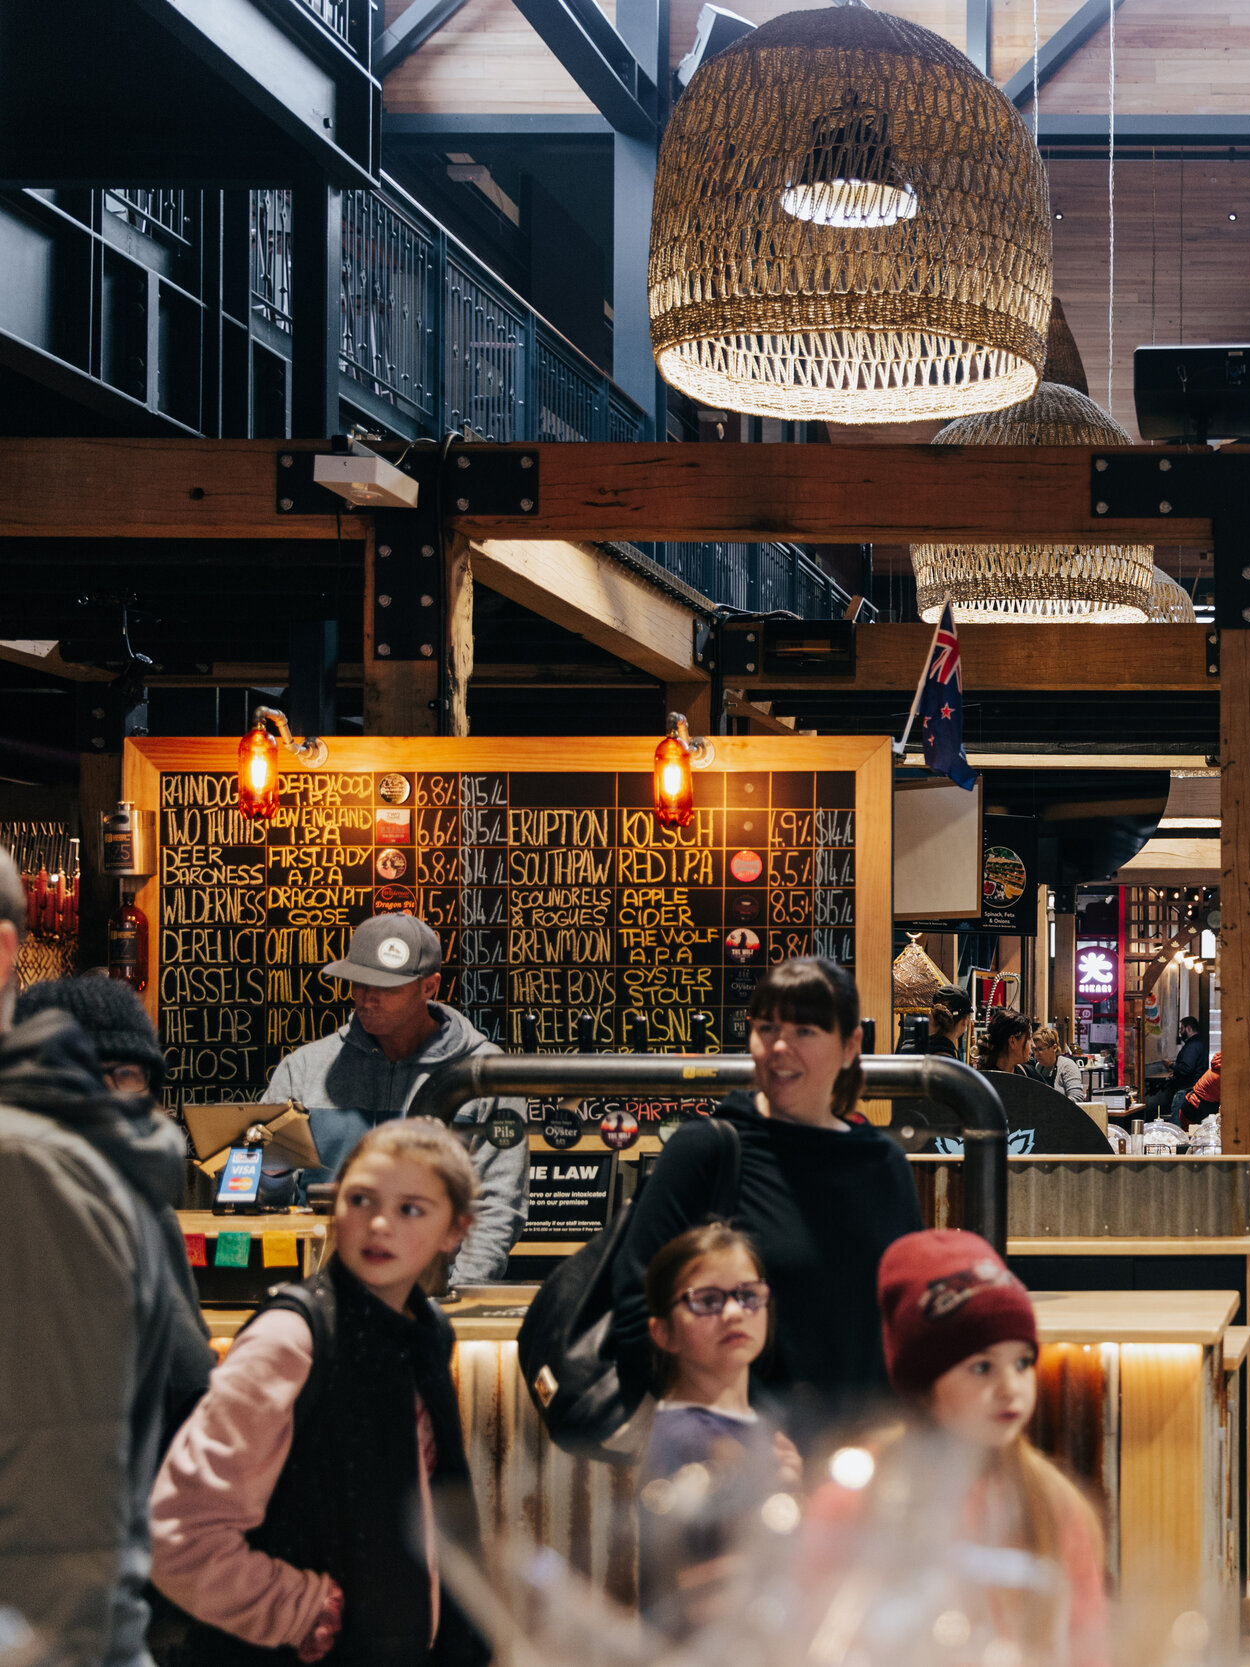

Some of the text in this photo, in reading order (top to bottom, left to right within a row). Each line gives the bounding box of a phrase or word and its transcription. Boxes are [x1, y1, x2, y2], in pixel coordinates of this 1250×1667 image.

[278, 773, 374, 798] DEADWOOD
[417, 775, 457, 807] 6.8%
[296, 791, 342, 806] I.P.A
[163, 807, 266, 846] TWO THUMB
[303, 807, 373, 829] ENGLAND
[418, 809, 458, 847] 6.6%
[508, 809, 609, 848] ERUPTION
[770, 811, 812, 848] 4.9%
[291, 826, 341, 845] I.P.A
[163, 846, 224, 867] BEER
[268, 846, 318, 869] FIRST
[321, 846, 374, 868] LADY
[418, 847, 459, 885] 5.8%
[510, 849, 613, 886] SOUTHPAW
[618, 848, 713, 885] RED I.P.A
[163, 864, 265, 886] BARONESS
[288, 867, 343, 886] A.P.A
[769, 851, 812, 887] 5.5%
[162, 887, 266, 926] WILDERNESS
[268, 886, 373, 909] DRAGON PIT
[375, 900, 415, 910] Dragon Pit
[511, 888, 612, 909] SCOUNDRELS
[623, 887, 689, 908] APPLE
[770, 889, 812, 924] 8.5%
[288, 907, 350, 926] GOSE
[511, 905, 609, 927] & ROGUES
[618, 905, 696, 928] CIDER
[162, 928, 266, 965] DERELICT
[265, 927, 298, 966] OAT
[299, 927, 341, 965] MILK
[618, 928, 720, 948] THE WOLF
[630, 946, 693, 966] A.P.A
[161, 965, 265, 1005] CASSELS
[268, 967, 315, 1006] MILK
[510, 968, 617, 1007] THREE BOYS
[624, 967, 713, 986] OYSTER
[628, 985, 714, 1007] STOUT
[1079, 984, 1112, 993] HIKARI
[162, 1006, 252, 1044] THE LAB
[267, 1006, 339, 1046] APOLLO
[567, 1006, 614, 1044] BYS
[734, 1022, 746, 1032] Pil
[162, 1046, 259, 1081] GHOST
[493, 1126, 515, 1138] Pils
[545, 1125, 578, 1138] Oyster
[232, 1165, 256, 1175] VISA
[553, 1166, 600, 1180] LAW
[559, 1199, 589, 1207] premises
